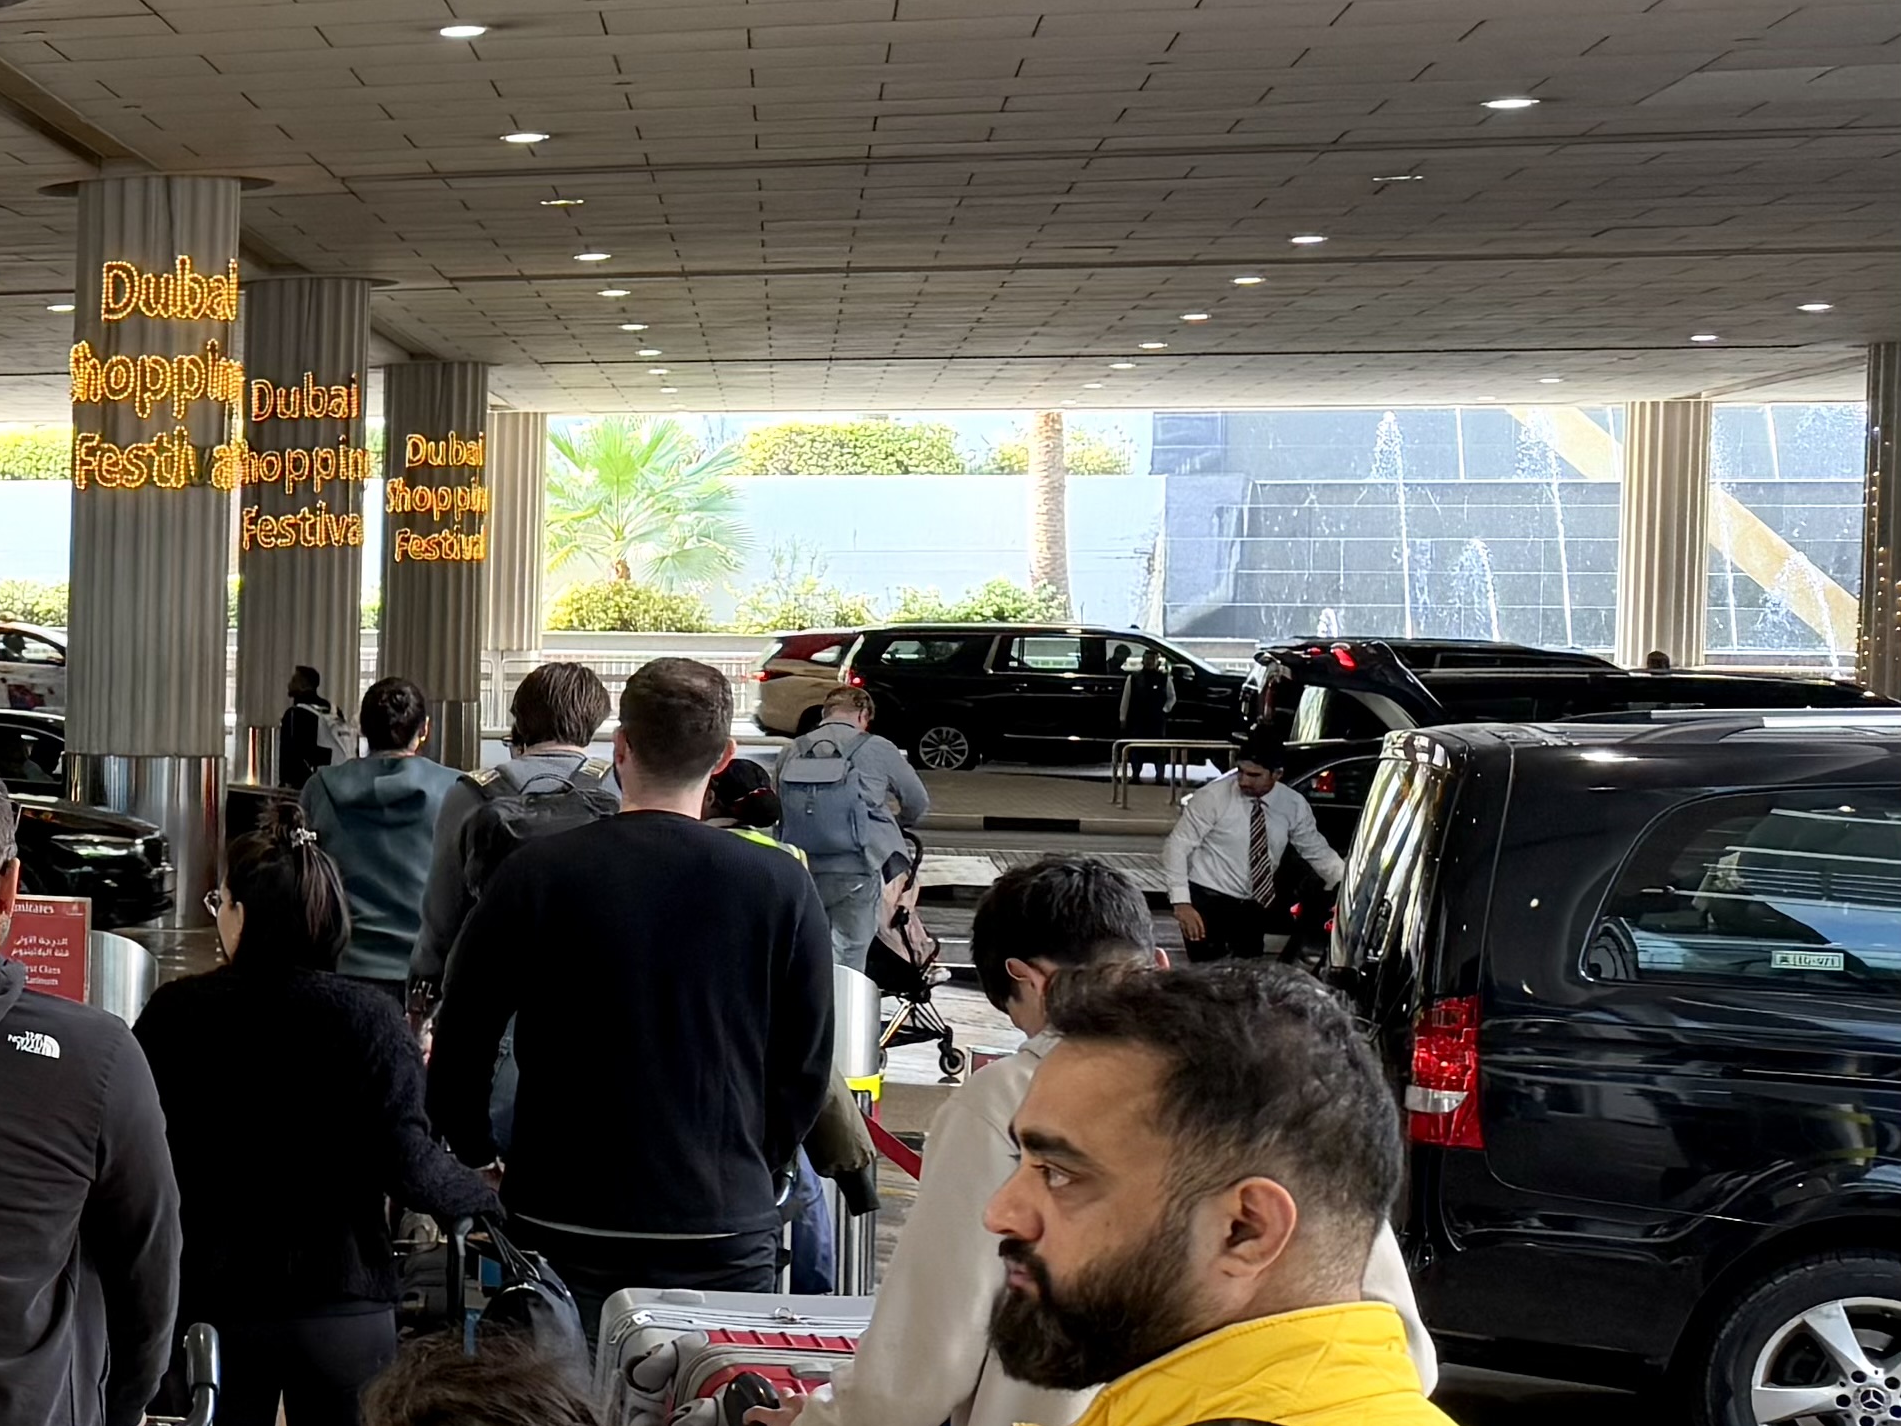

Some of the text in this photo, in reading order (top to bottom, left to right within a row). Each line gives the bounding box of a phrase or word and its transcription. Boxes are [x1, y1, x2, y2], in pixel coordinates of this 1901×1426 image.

[101, 255, 238, 322] Dubai
[251, 371, 358, 422] Dubai
[405, 430, 485, 468] Dubai
[385, 475, 489, 522] Shoppin
[242, 500, 364, 551] Festiva
[13, 902, 55, 914] mirates
[25, 975, 59, 985] latinum
